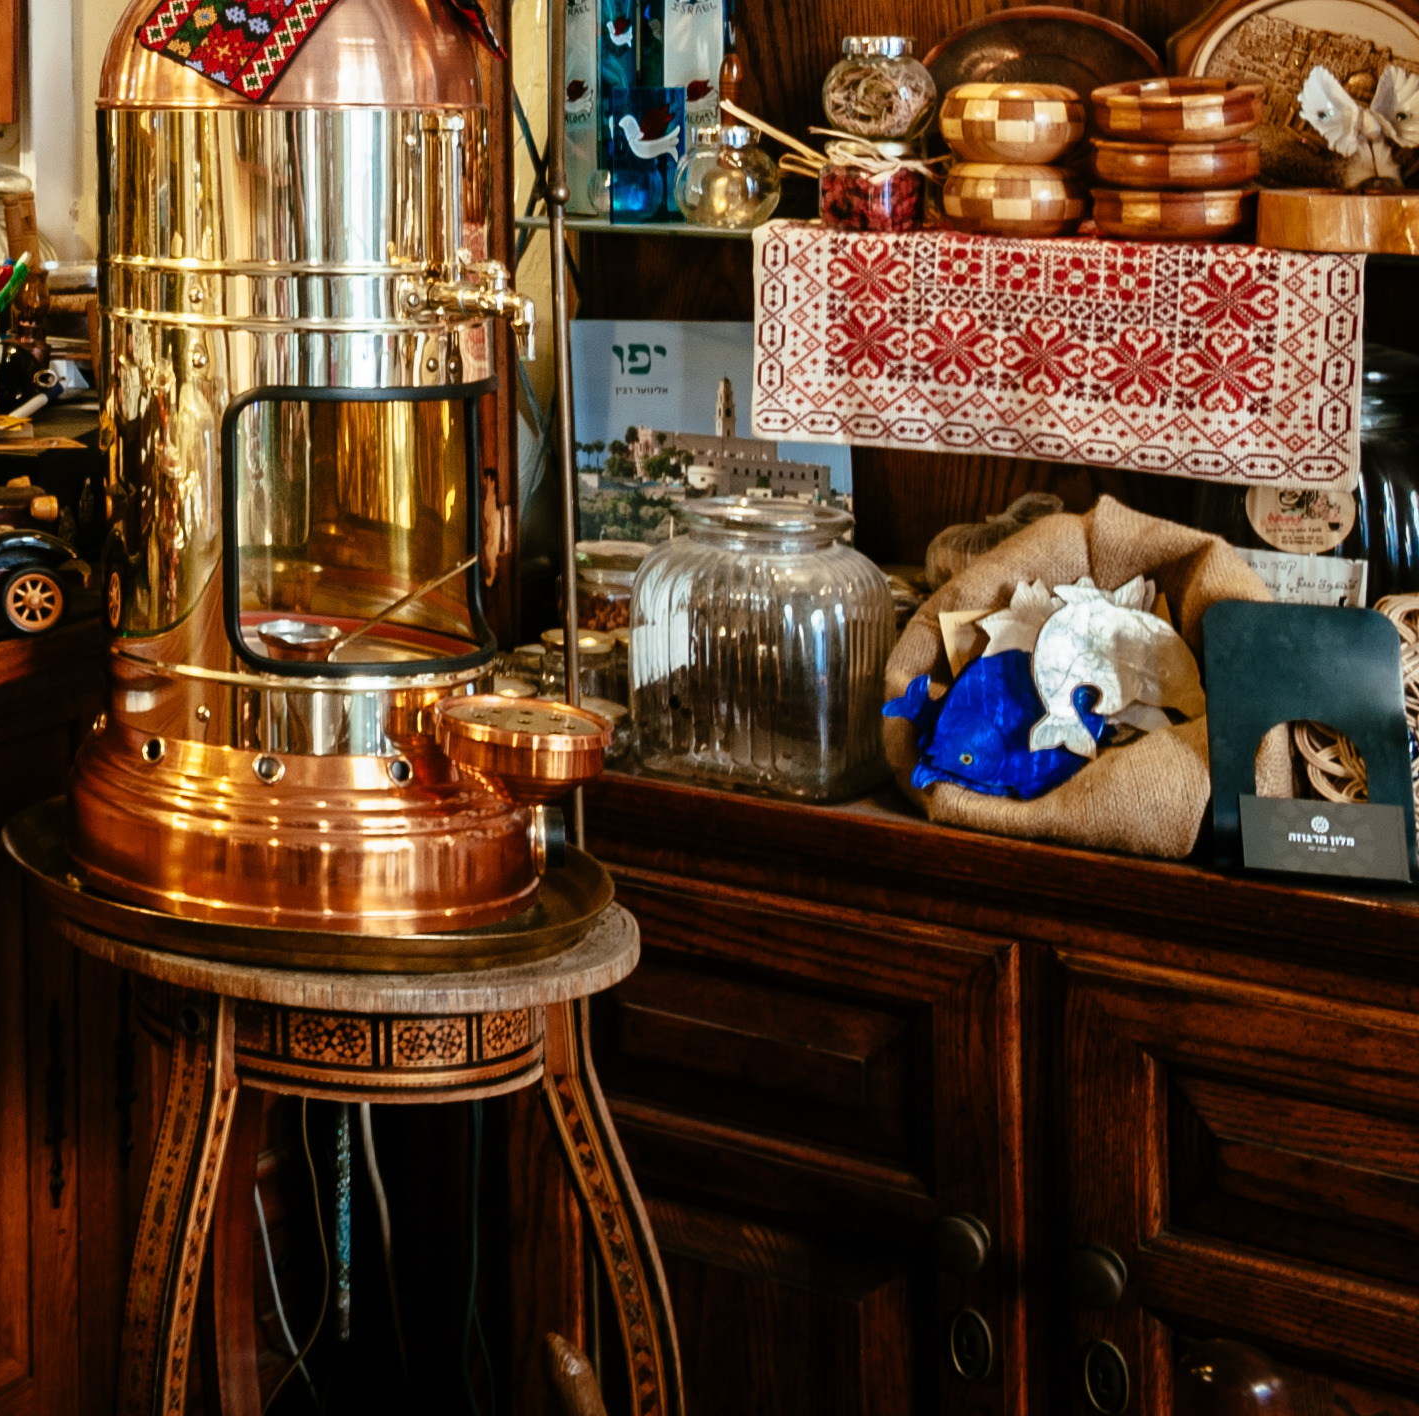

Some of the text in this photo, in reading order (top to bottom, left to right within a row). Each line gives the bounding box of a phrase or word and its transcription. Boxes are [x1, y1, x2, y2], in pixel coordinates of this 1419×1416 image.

[611, 343, 668, 375] יפו
[1288, 832, 1356, 848] מלון מרגוזה
